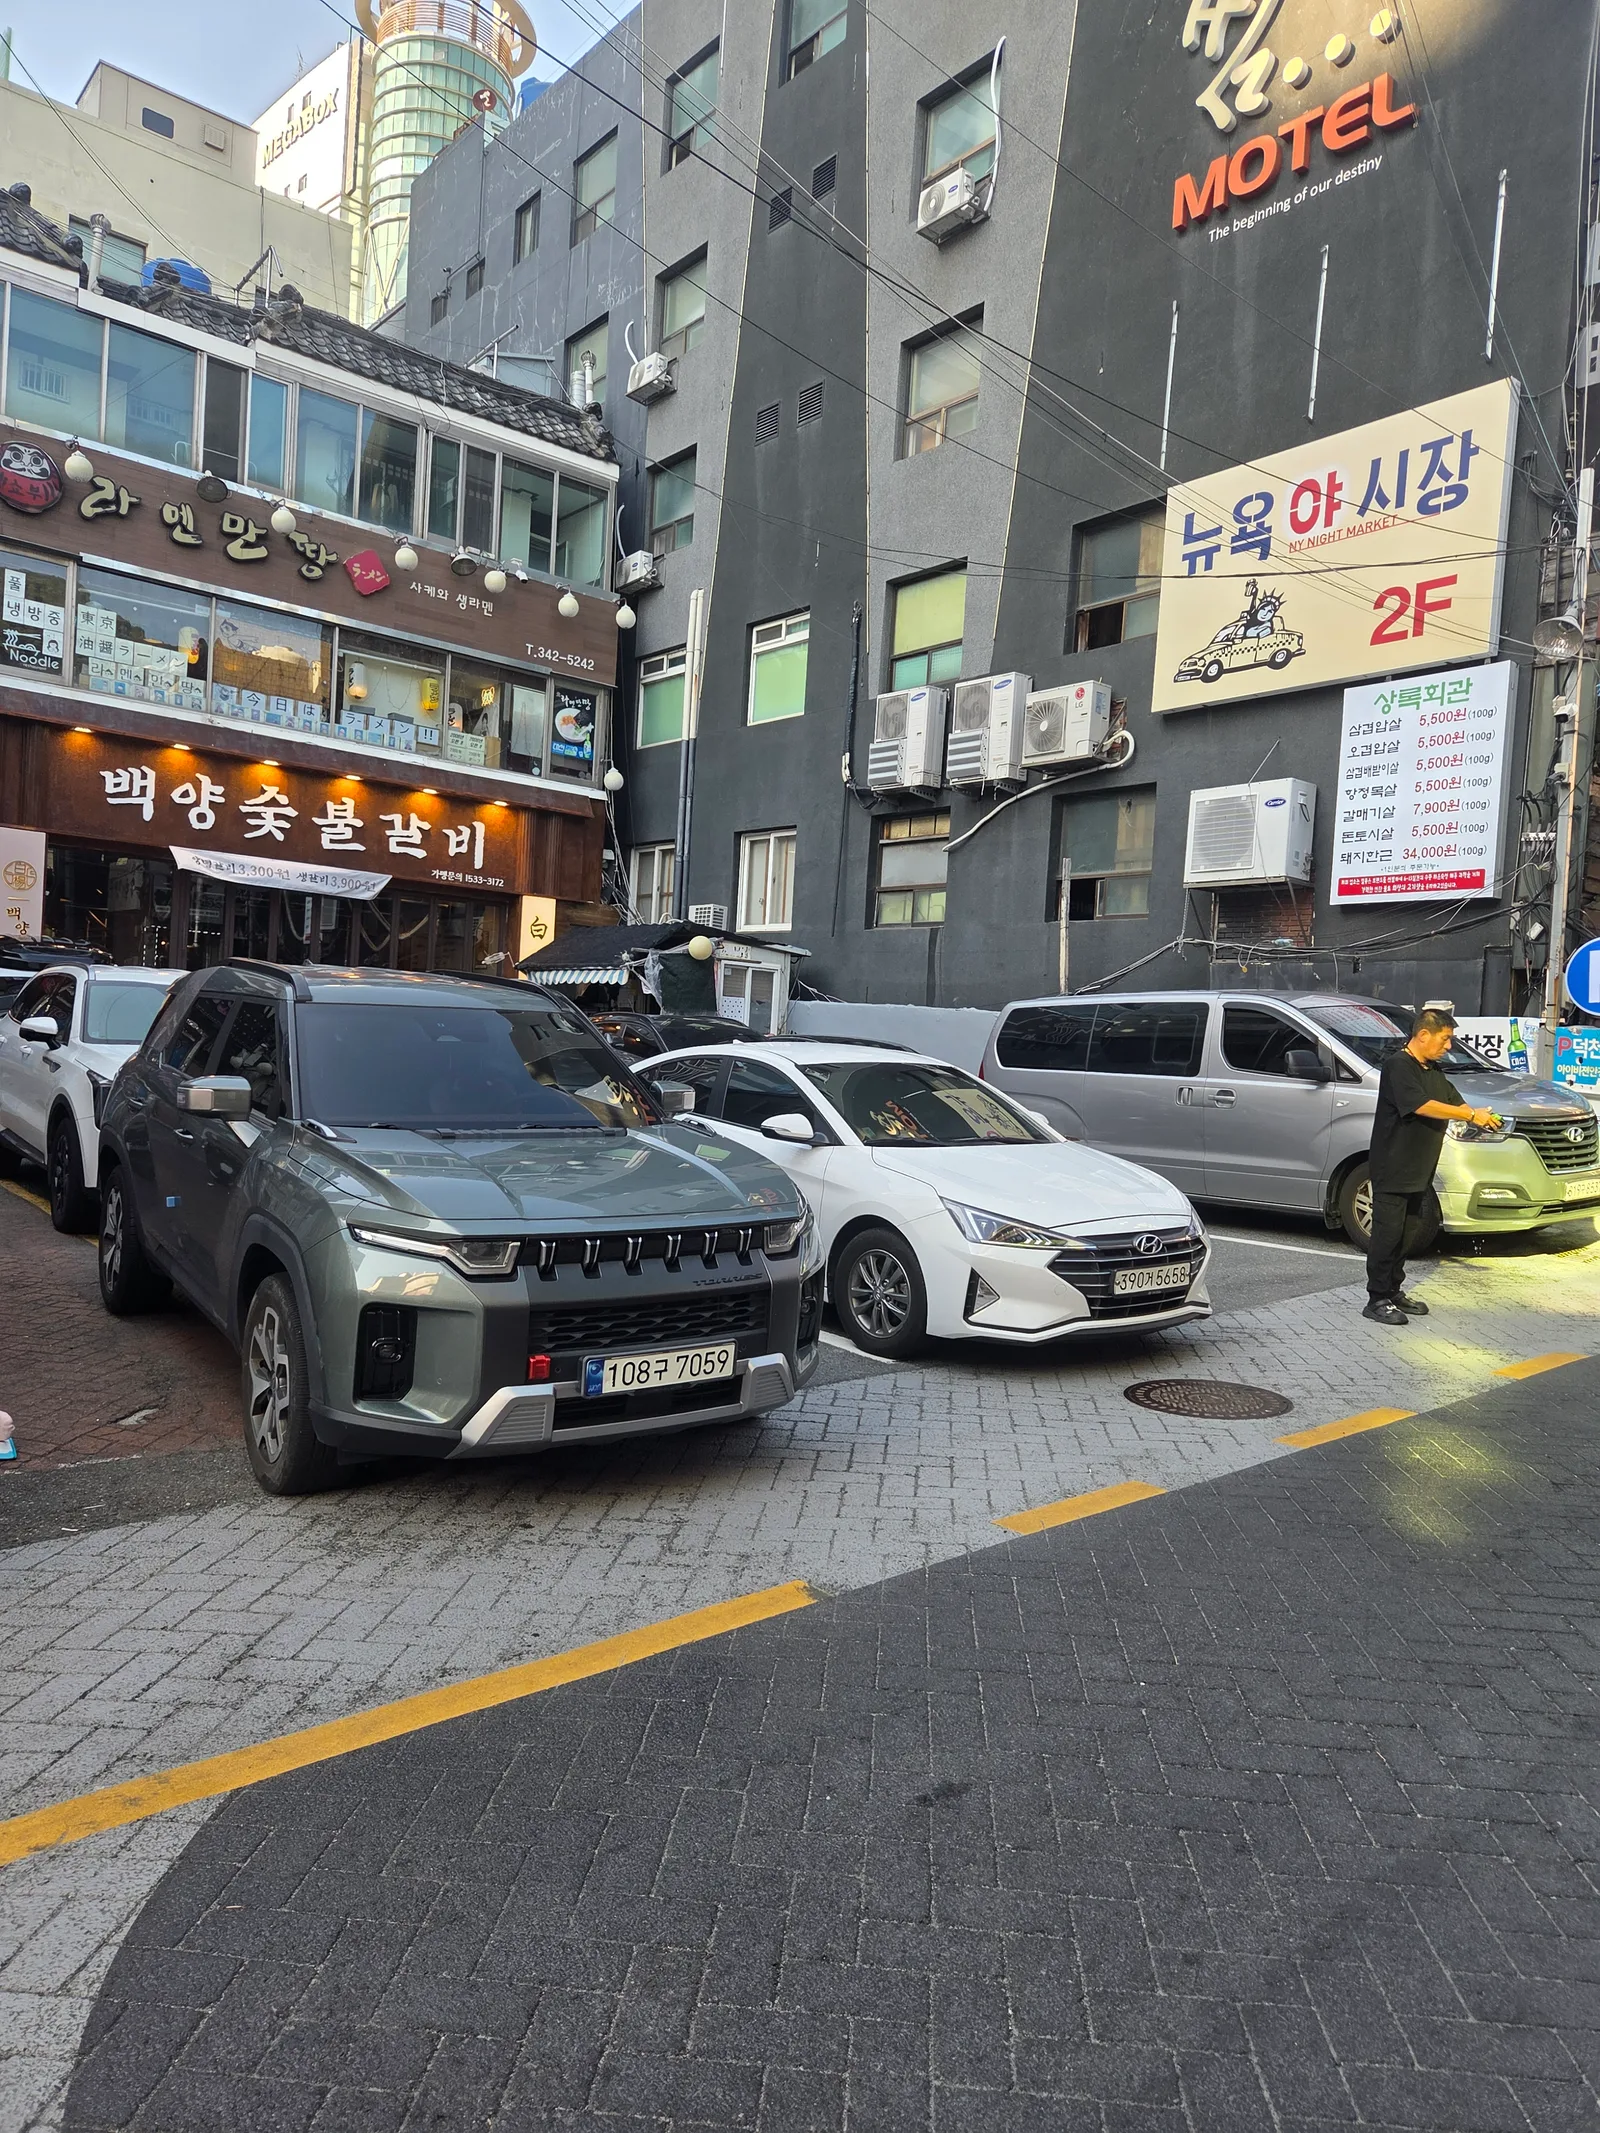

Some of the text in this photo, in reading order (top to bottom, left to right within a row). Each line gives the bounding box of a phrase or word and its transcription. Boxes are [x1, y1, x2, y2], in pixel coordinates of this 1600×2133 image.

[262, 88, 339, 168] MEGABOX
[1171, 71, 1417, 233] MOTEL
[1208, 155, 1382, 243] The beginning of our destiny
[1289, 513, 1399, 553] NY NIGHT MARKET
[8, 575, 22, 592] 풀
[409, 580, 494, 617] 사케와 생라멘
[1370, 574, 1458, 646] 2F
[8, 600, 62, 626] 냉방중
[10, 649, 60, 670] Noodle
[525, 643, 596, 671] T.342-5242
[1075, 701, 1084, 709] LG
[1374, 677, 1473, 715] 상록회관
[1345, 783, 1398, 801] 항정목살
[1343, 805, 1396, 823] 갈매기살
[1340, 848, 1393, 865] 돼지한근
[431, 869, 504, 887] 가맹문의 1533-3172
[1454, 1033, 1504, 1059] 차장
[1156, 1266, 1186, 1286] 5658
[607, 1348, 731, 1388] 108구 7059
